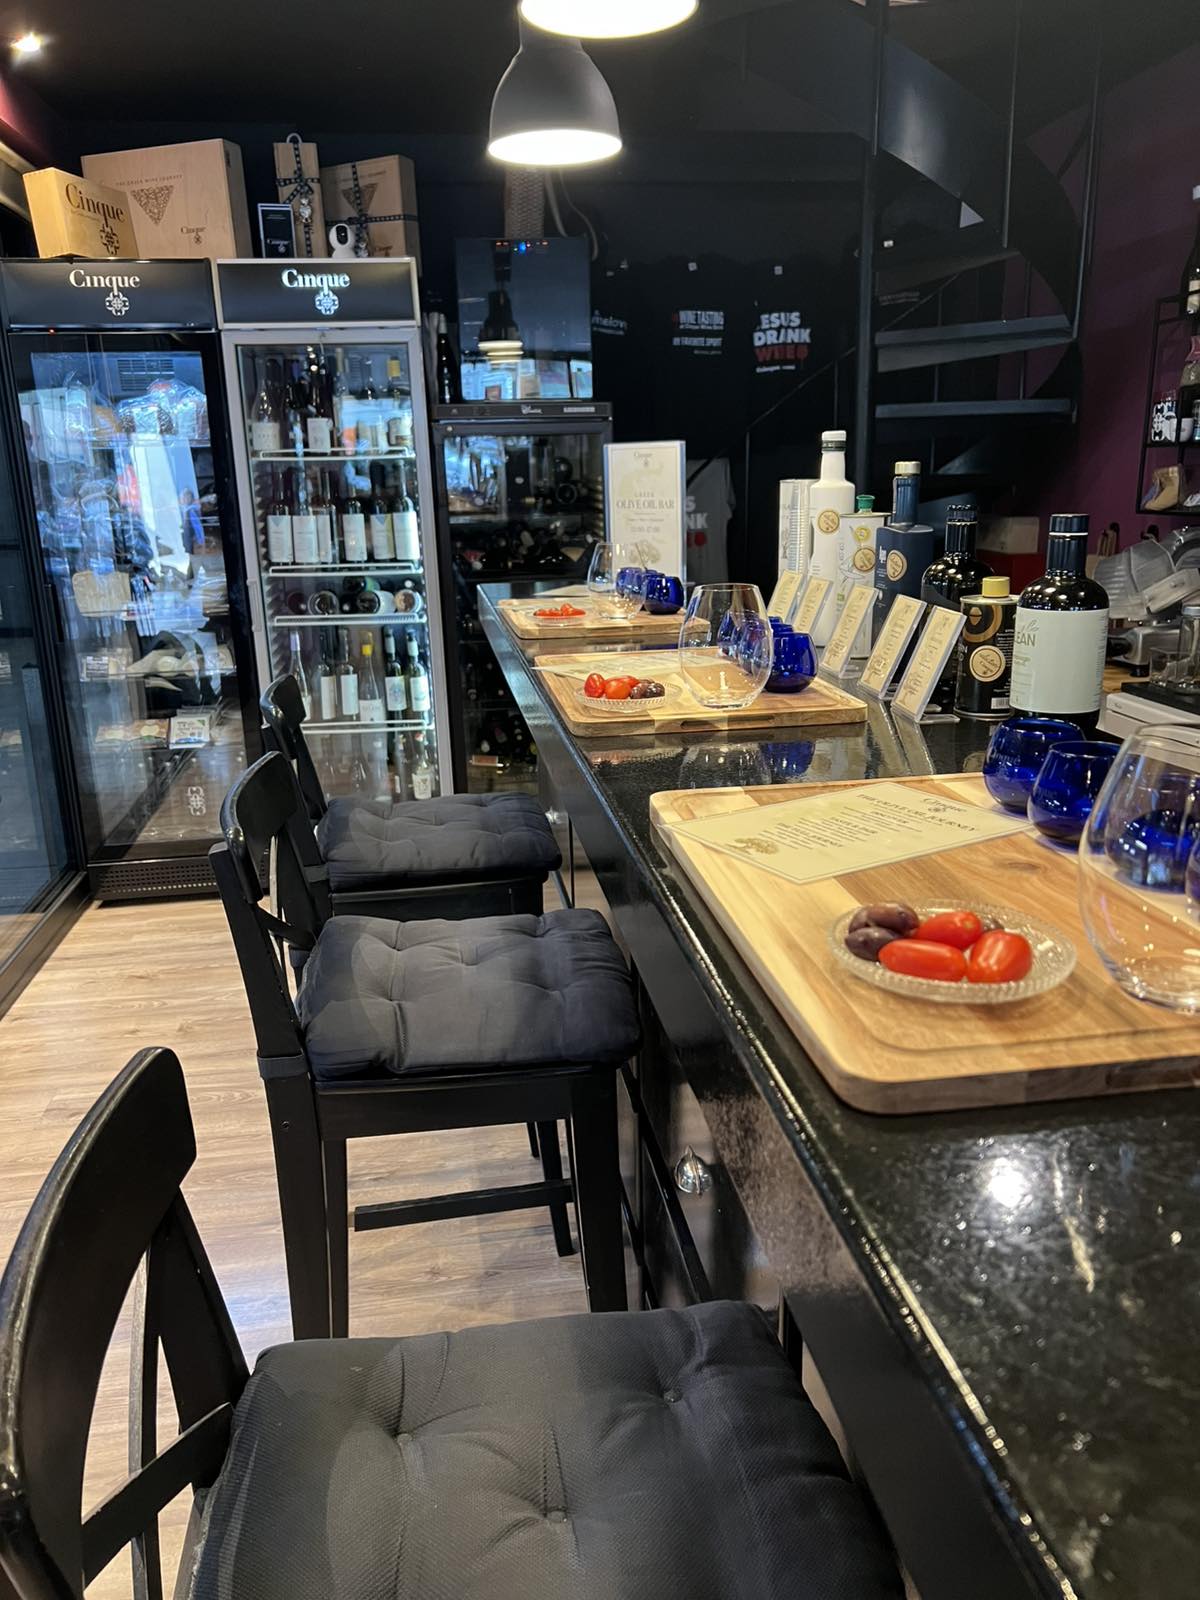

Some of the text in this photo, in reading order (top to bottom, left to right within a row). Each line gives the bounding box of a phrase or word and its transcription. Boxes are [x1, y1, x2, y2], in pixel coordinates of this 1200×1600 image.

[65, 183, 126, 228] Cinque
[69, 269, 141, 293] Cinque
[281, 269, 351, 293] Cinque
[616, 498, 641, 509] OLIVE
[642, 498, 657, 509] OIL
